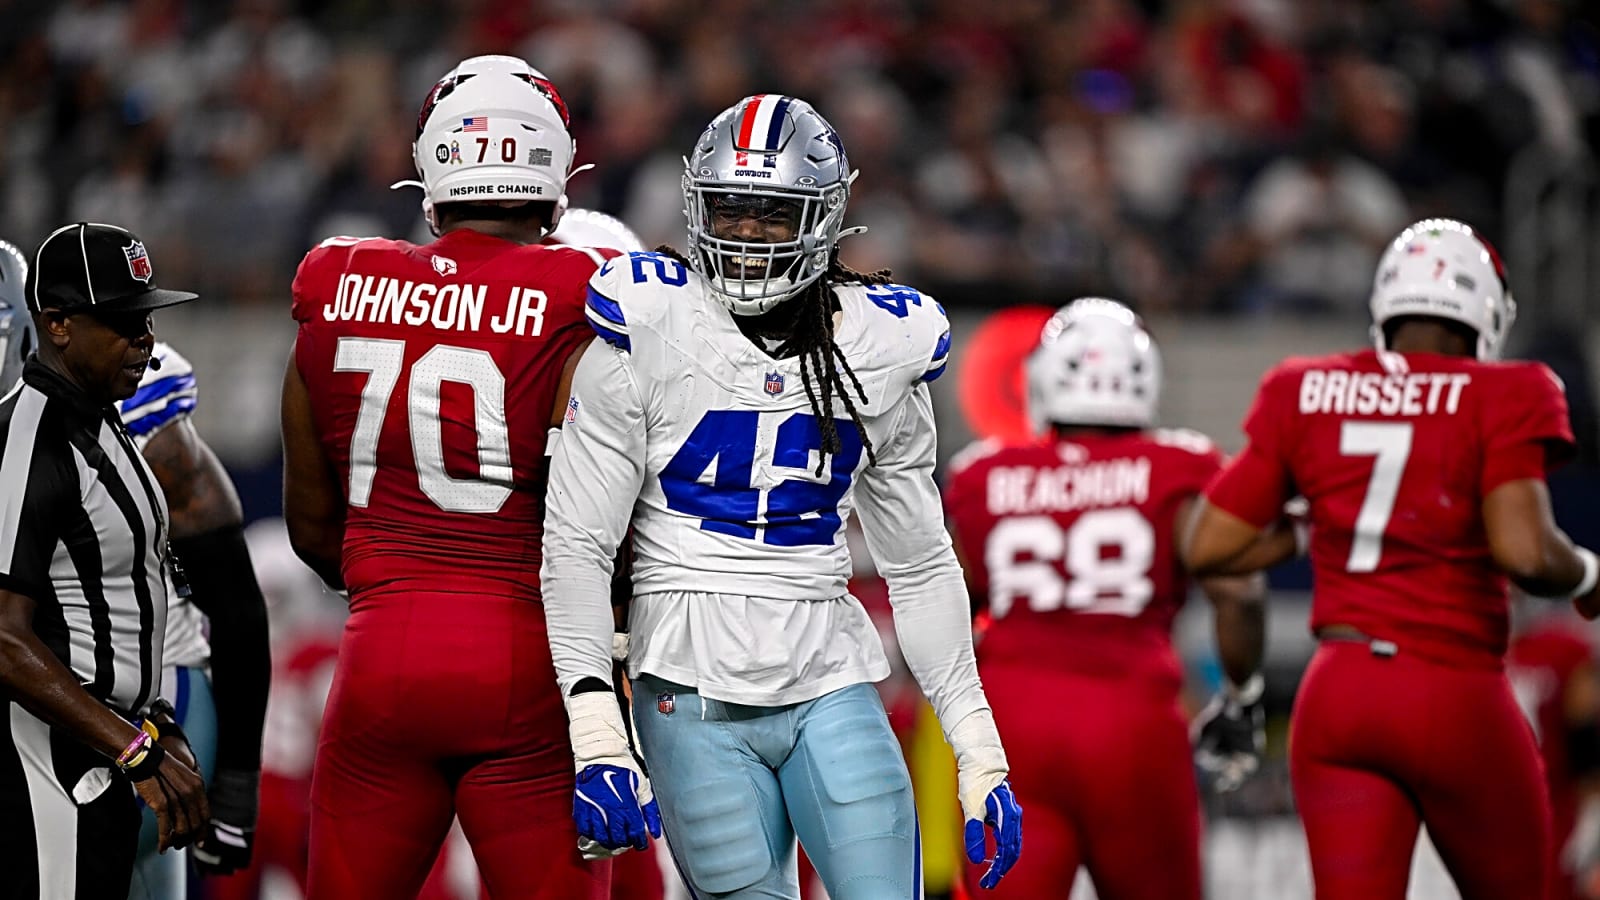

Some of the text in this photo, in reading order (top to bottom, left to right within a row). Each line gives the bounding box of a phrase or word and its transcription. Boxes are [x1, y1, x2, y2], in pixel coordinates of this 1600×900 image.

[449, 184, 543, 197] INSPIRE CHANGE
[734, 169, 772, 179] COWBOYS
[322, 273, 548, 336] JOHNSON JR
[333, 336, 515, 513] 70
[1299, 370, 1471, 416] BRISSETT
[658, 410, 864, 546] 42
[986, 457, 1151, 515] BEACHUM
[1339, 421, 1413, 573] 7
[985, 507, 1155, 617] 68
